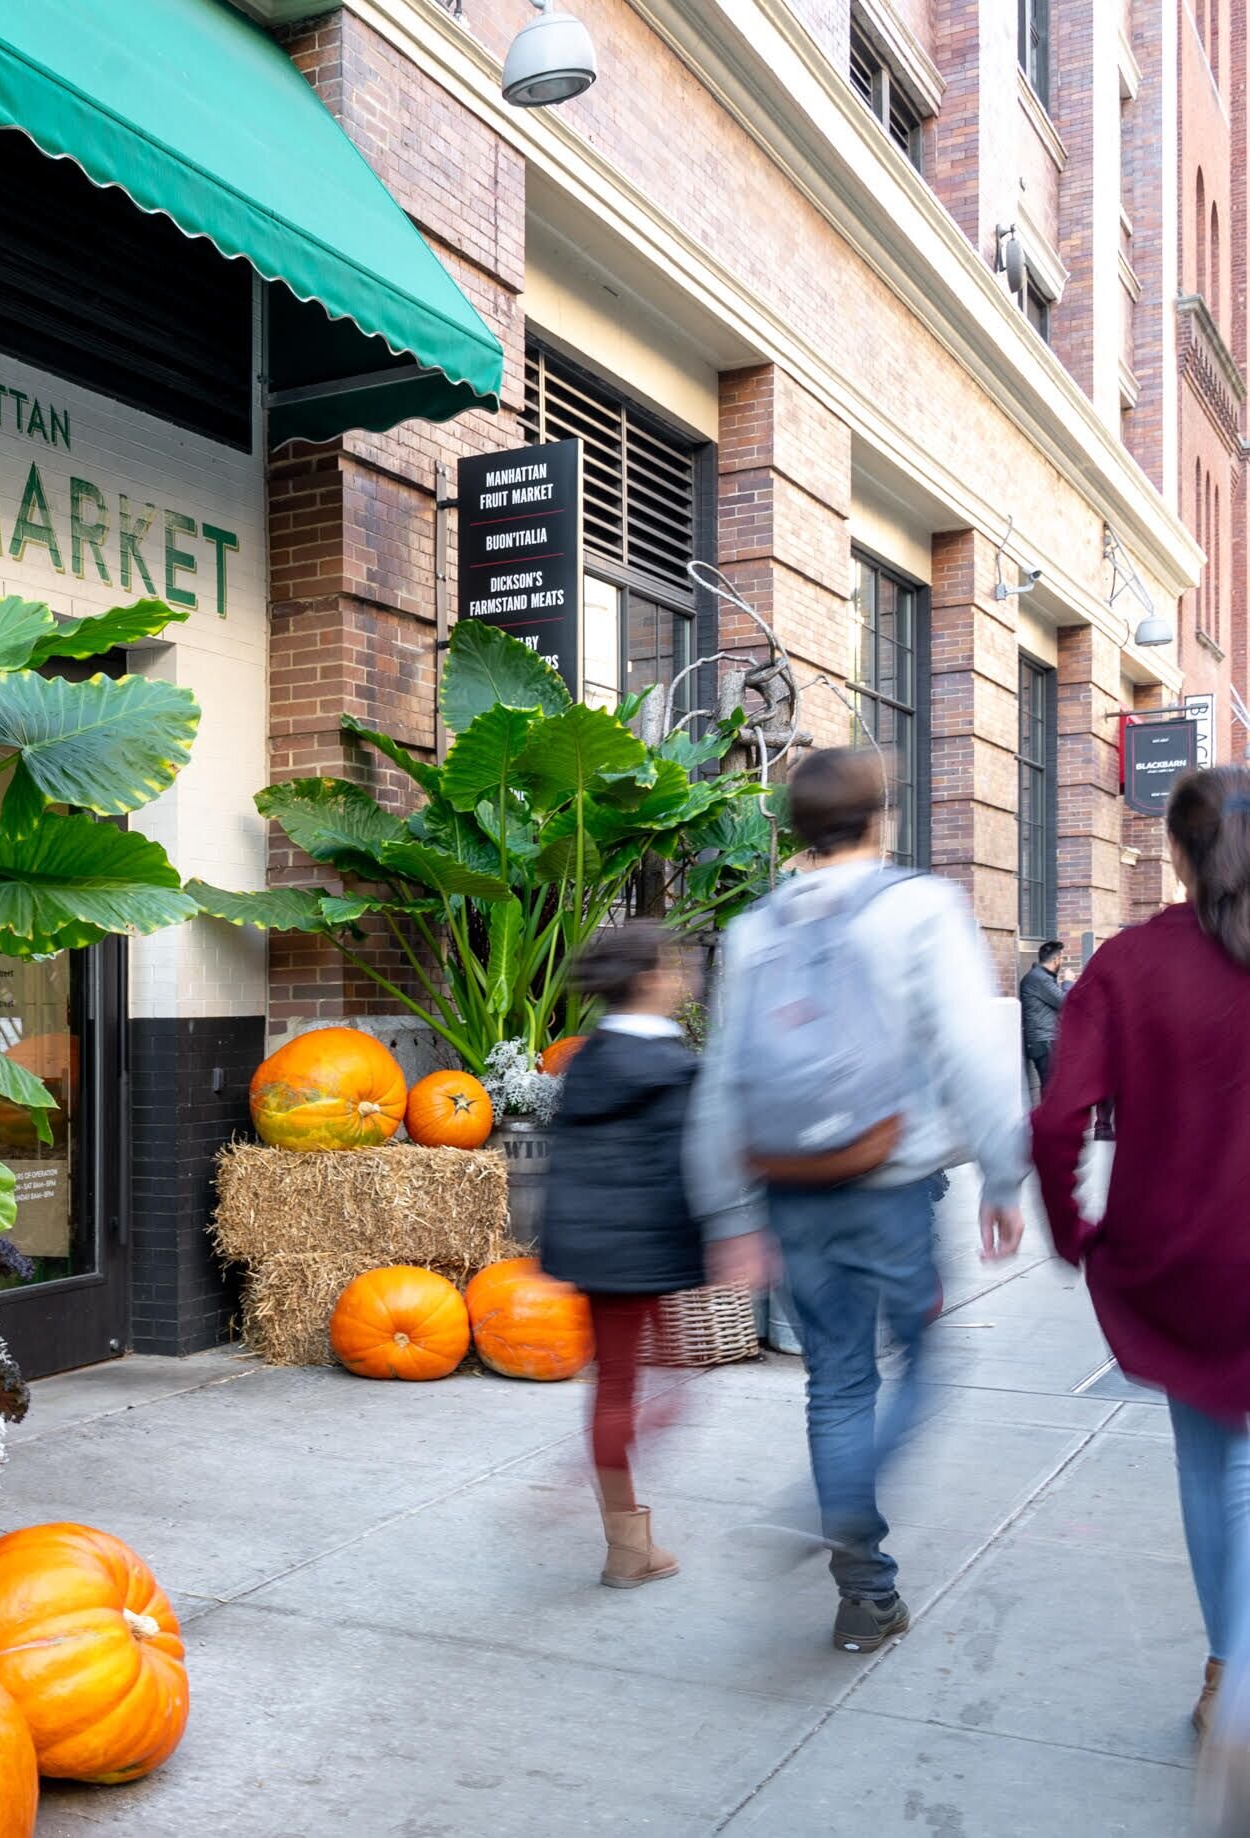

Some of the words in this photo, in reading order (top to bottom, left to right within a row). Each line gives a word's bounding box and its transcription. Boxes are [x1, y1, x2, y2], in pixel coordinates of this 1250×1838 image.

[486, 463, 547, 488] MANHATTAN
[480, 491, 508, 510] FRUIT
[512, 483, 553, 505] MARKET
[486, 528, 548, 551] BUON'ITALIA
[490, 571, 543, 592] DICKSON'S
[470, 594, 527, 616] FARMSTAND
[531, 589, 564, 608] MEATS
[1136, 759, 1187, 771] BLACKBARN
